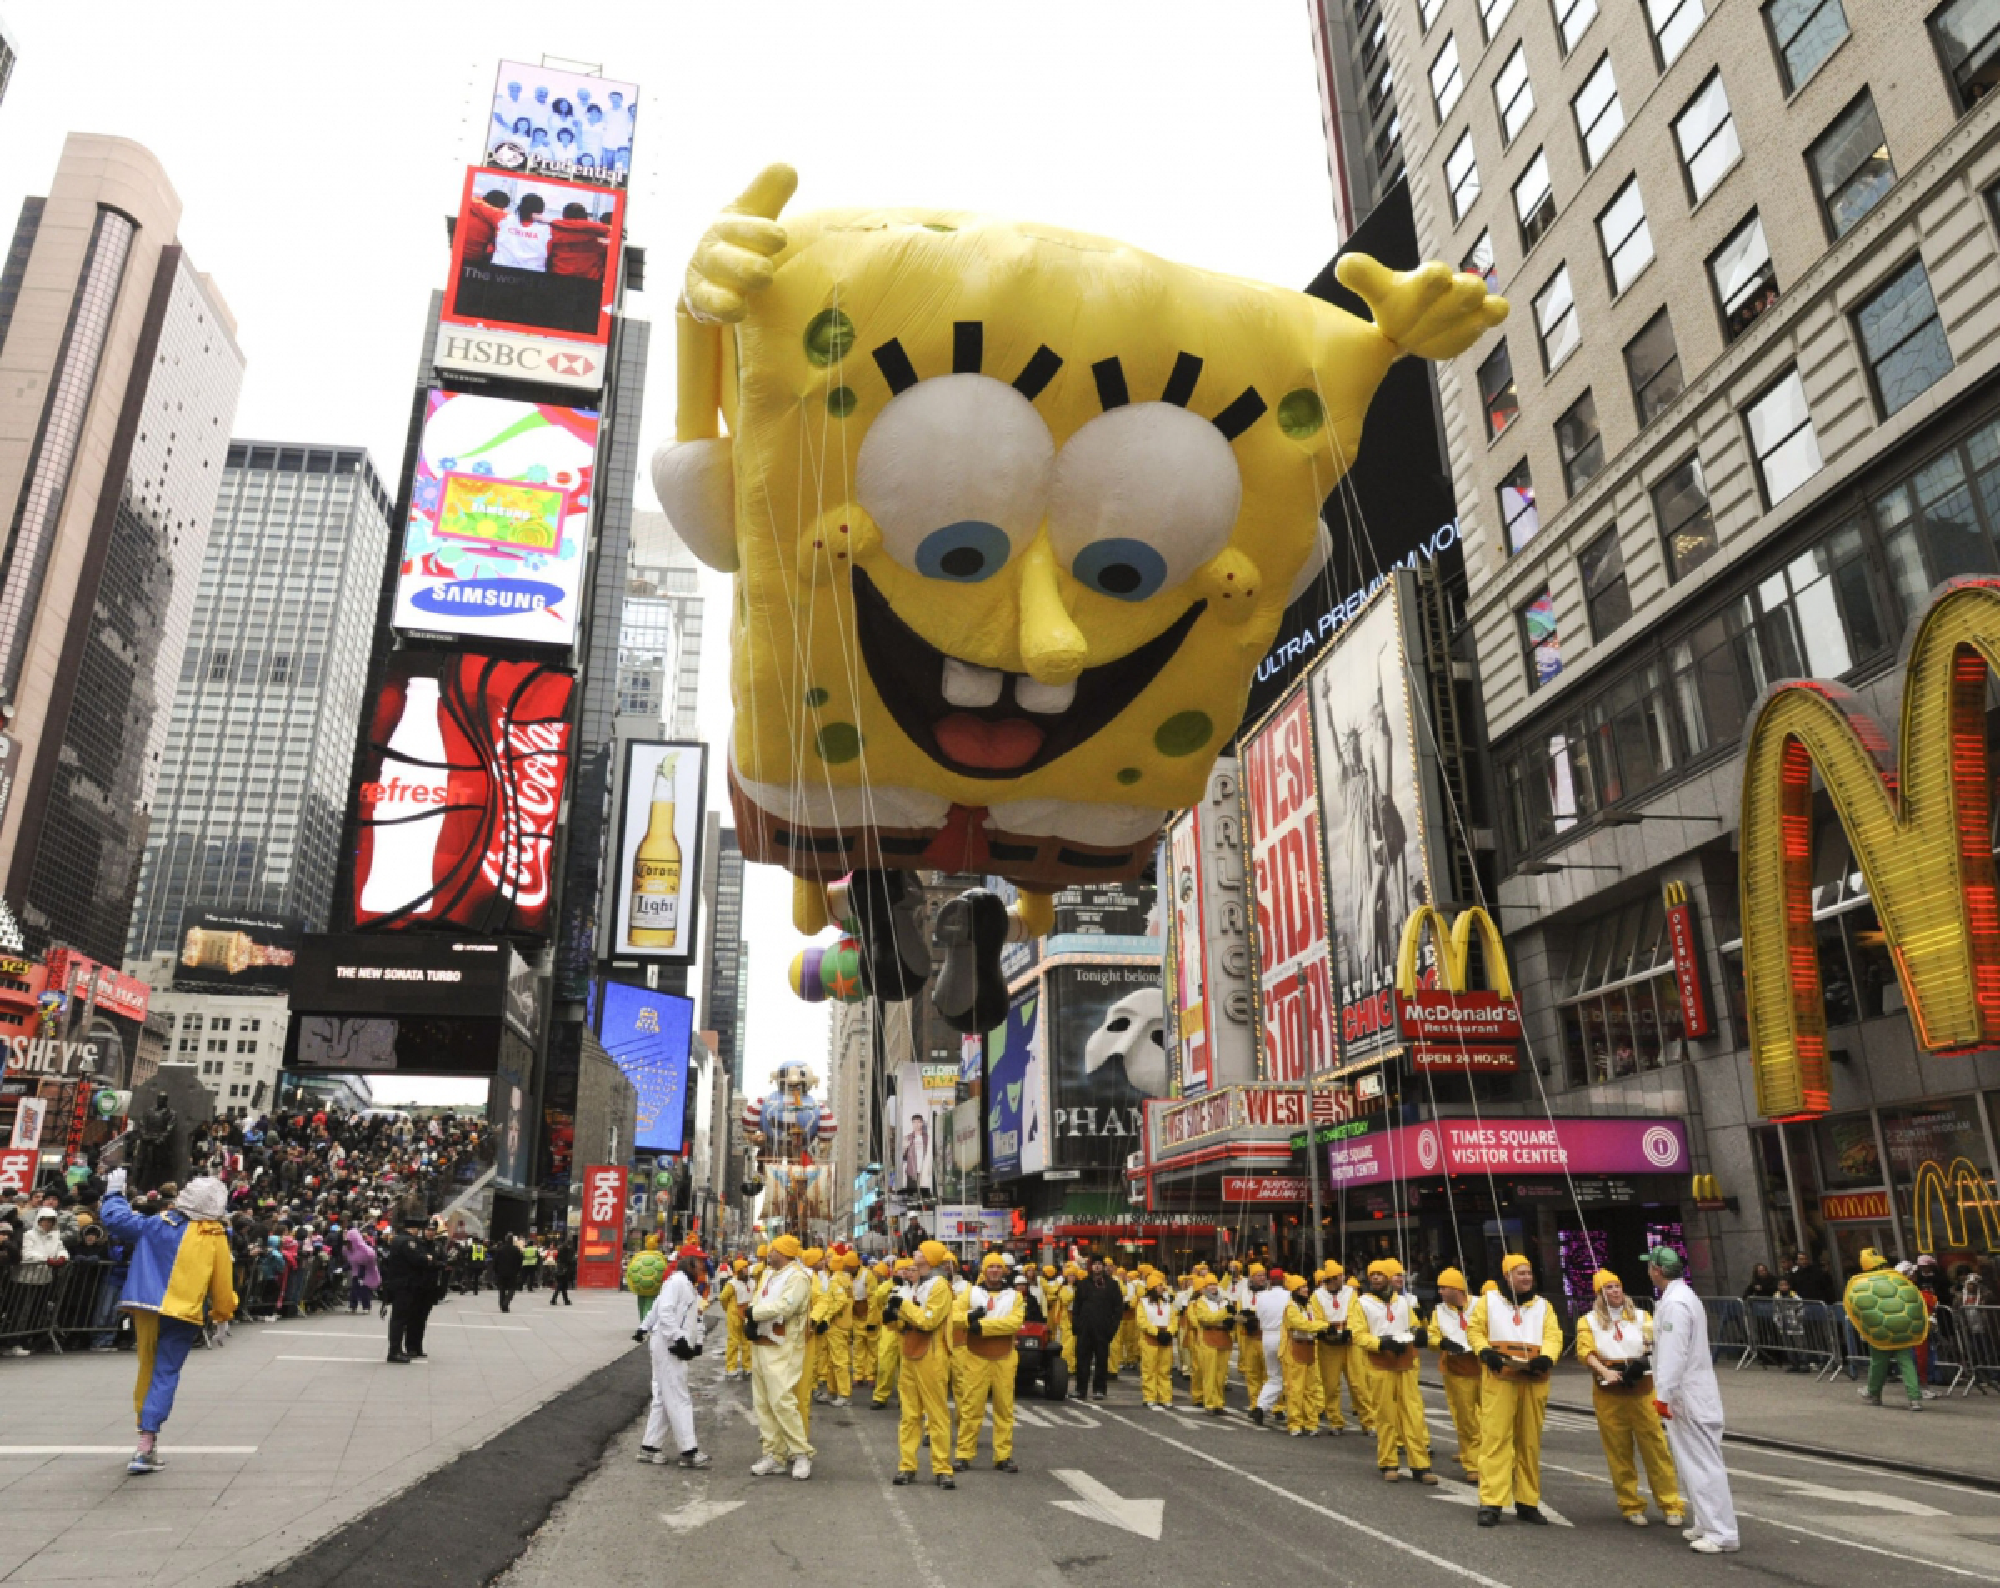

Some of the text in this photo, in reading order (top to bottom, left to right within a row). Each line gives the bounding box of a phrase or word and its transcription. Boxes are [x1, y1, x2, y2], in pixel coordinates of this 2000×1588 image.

[531, 151, 623, 183] Prudential
[464, 266, 490, 281] The
[443, 336, 542, 371] HSBC
[432, 585, 546, 610] SAMSUNG
[1257, 628, 1316, 682] ULTRA
[1211, 772, 1253, 1026] PALACE
[1252, 808, 1330, 976] SIDE
[636, 895, 675, 916] Light
[336, 966, 357, 979] THE
[358, 967, 383, 980] NEW
[383, 968, 424, 981] SONATA
[1074, 967, 1122, 986] Tonight
[1672, 912, 1687, 958] OPEN
[1682, 973, 1699, 1032] HOURS
[1405, 1005, 1519, 1021] McDonald's
[1424, 1022, 1499, 1034] Restaurant
[1416, 1053, 1453, 1064] OPEN
[1454, 1054, 1471, 1064] 24
[1242, 1089, 1305, 1126] WEST
[1450, 1130, 1557, 1146] TIMES SQUARE
[1452, 1149, 1568, 1164] VISITOR CENTER
[592, 1170, 621, 1222] tkts
